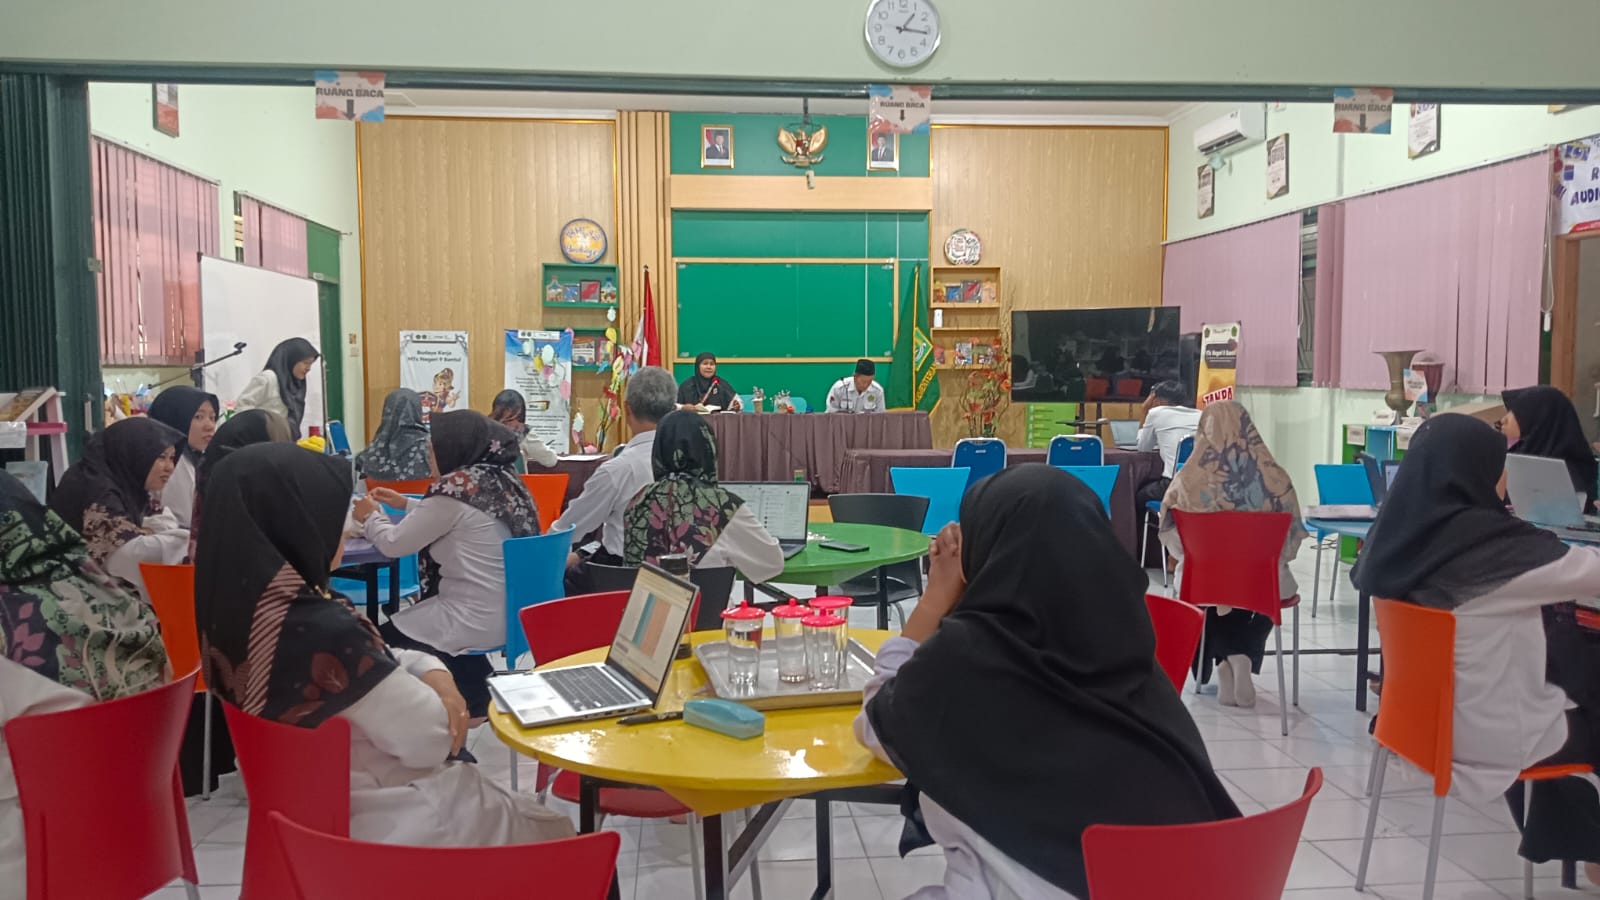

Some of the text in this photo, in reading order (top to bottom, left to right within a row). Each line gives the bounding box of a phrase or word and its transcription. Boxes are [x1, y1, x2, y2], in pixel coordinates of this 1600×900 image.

[878, 11, 889, 20] 10
[920, 12, 928, 21] 2
[874, 24, 882, 32] 9
[878, 36, 885, 45] 8
[919, 38, 927, 47] 4
[887, 45, 894, 55] 7
[897, 49, 906, 59] 6
[910, 47, 918, 56] 5
[316, 87, 384, 98] RUANG BACA
[1335, 103, 1392, 112] RUANG BACA
[1570, 187, 1600, 206] AUDI
